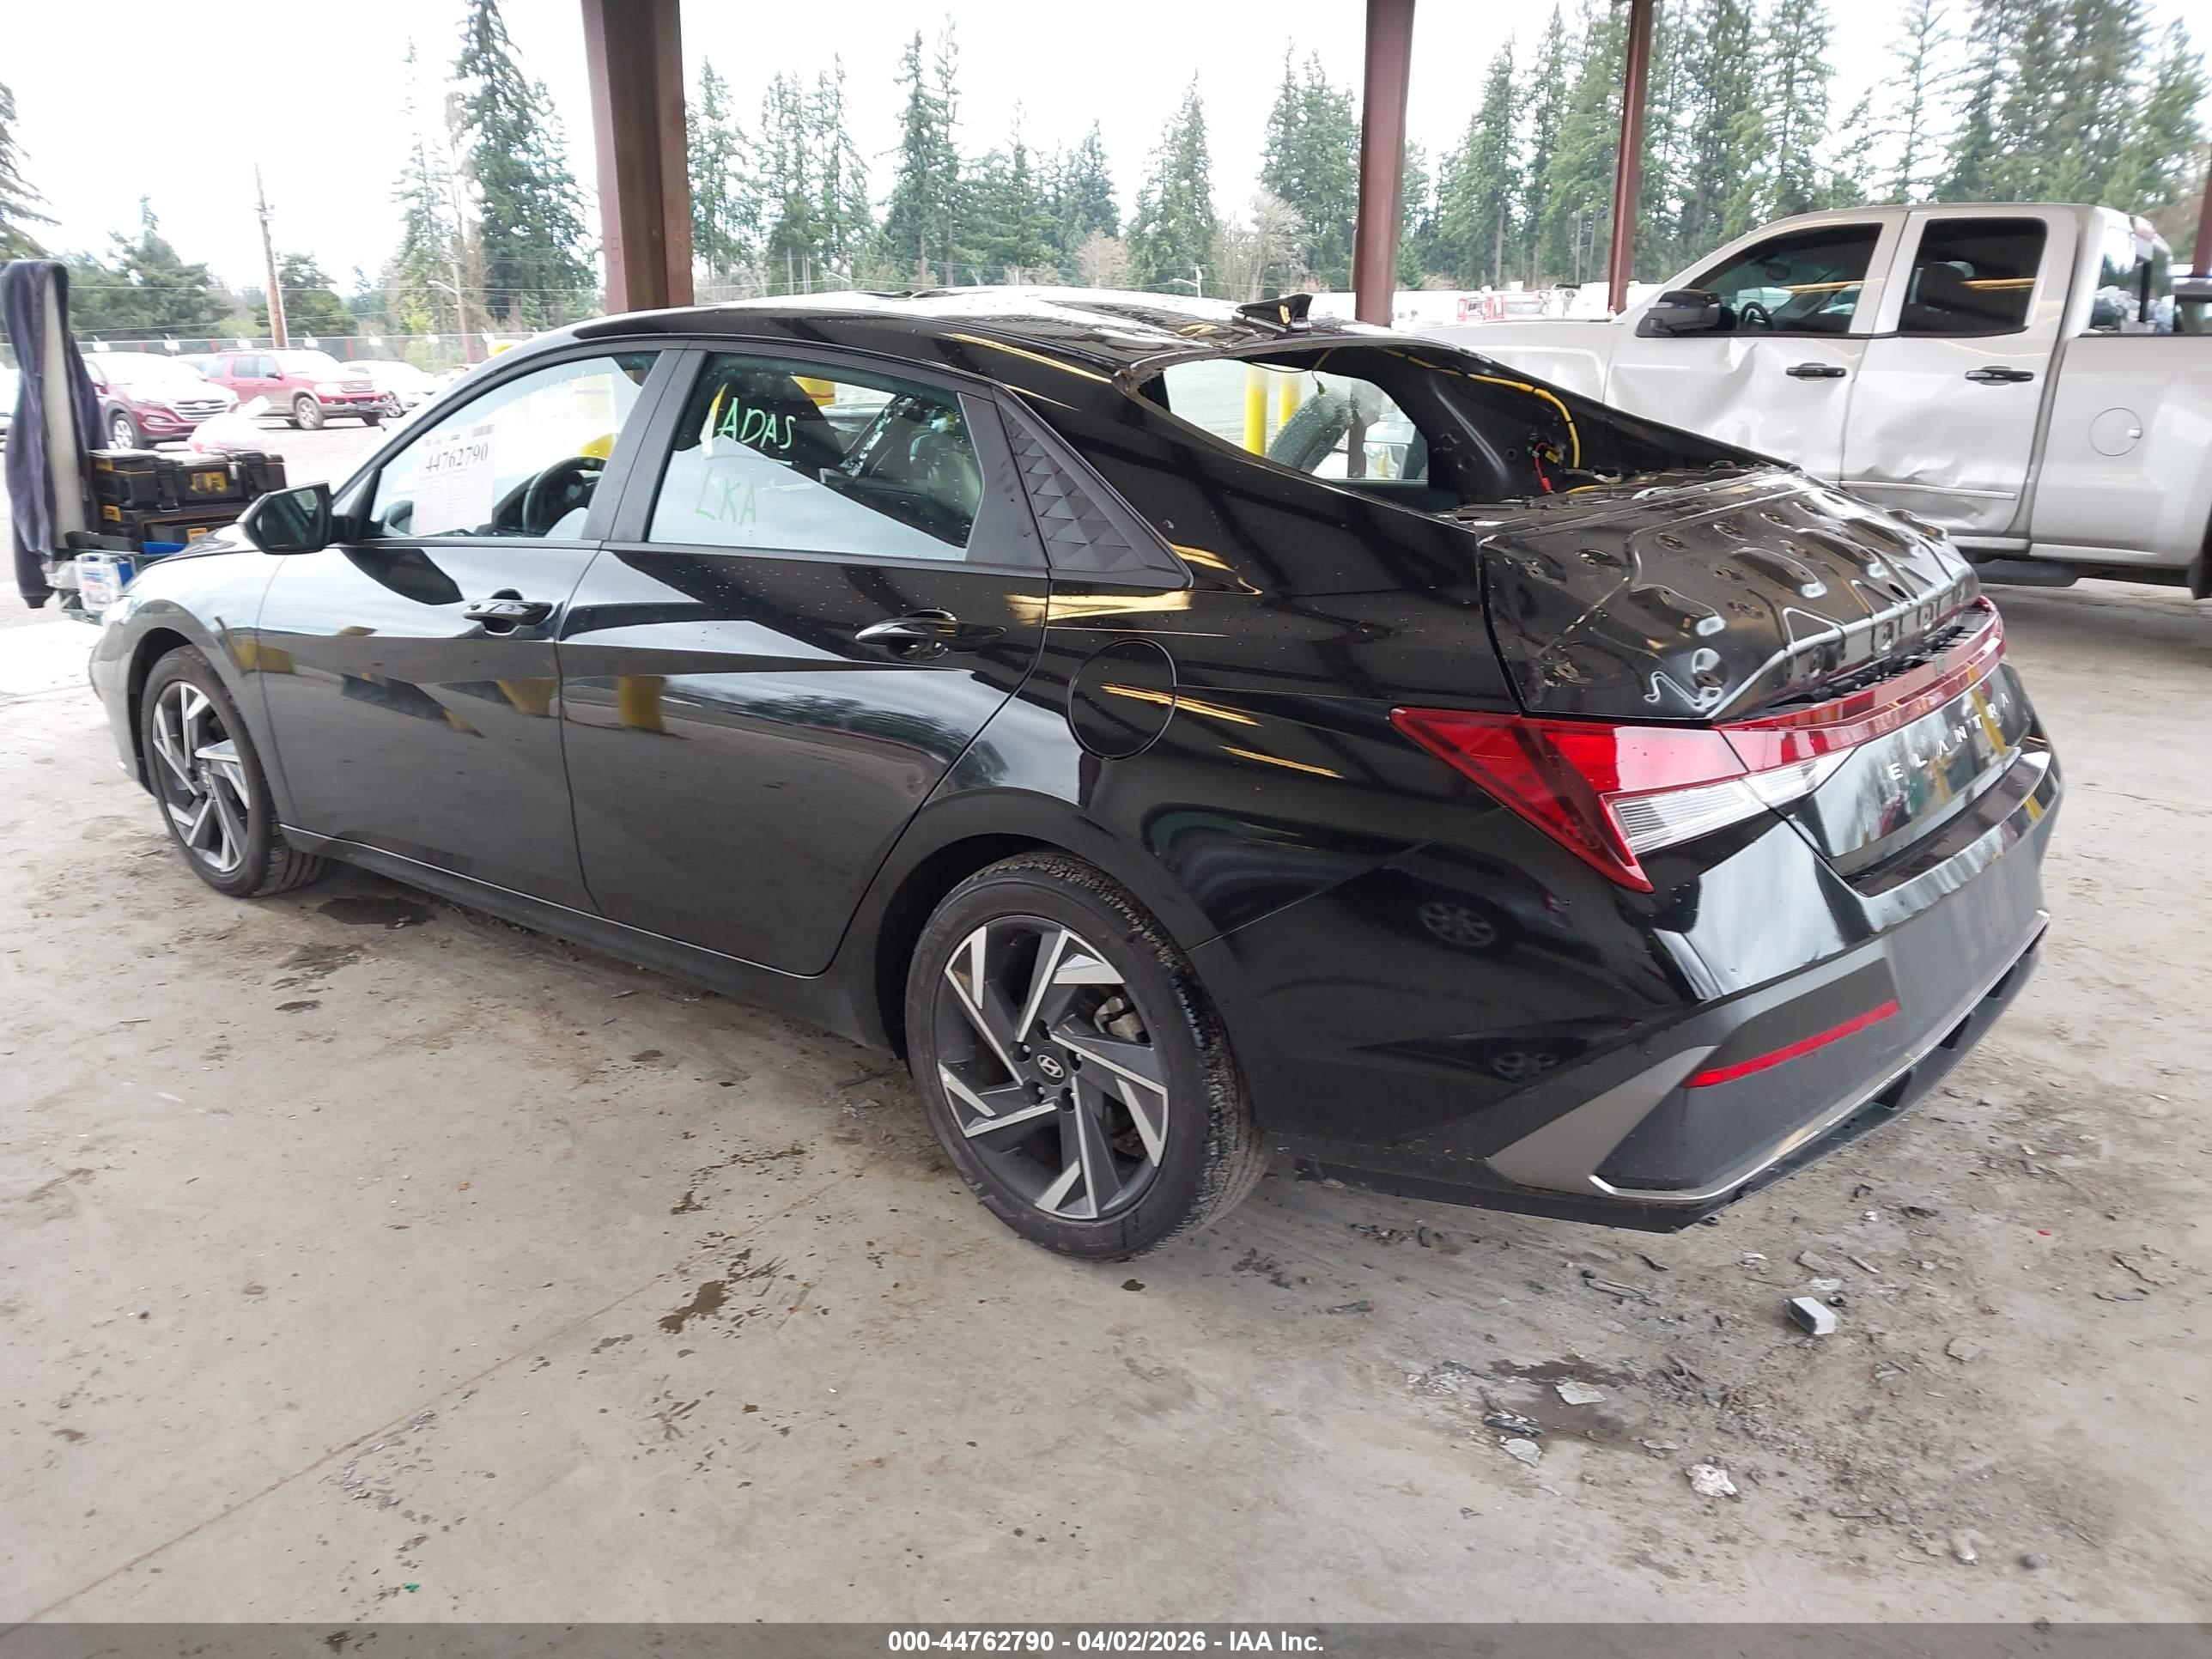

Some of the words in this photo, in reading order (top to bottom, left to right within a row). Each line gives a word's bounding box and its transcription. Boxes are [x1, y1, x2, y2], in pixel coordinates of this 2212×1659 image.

[717, 397, 796, 450] ADAS
[425, 442, 489, 472] 44762790
[695, 467, 757, 526] LKA
[1887, 692, 2010, 781] ELANTRA
